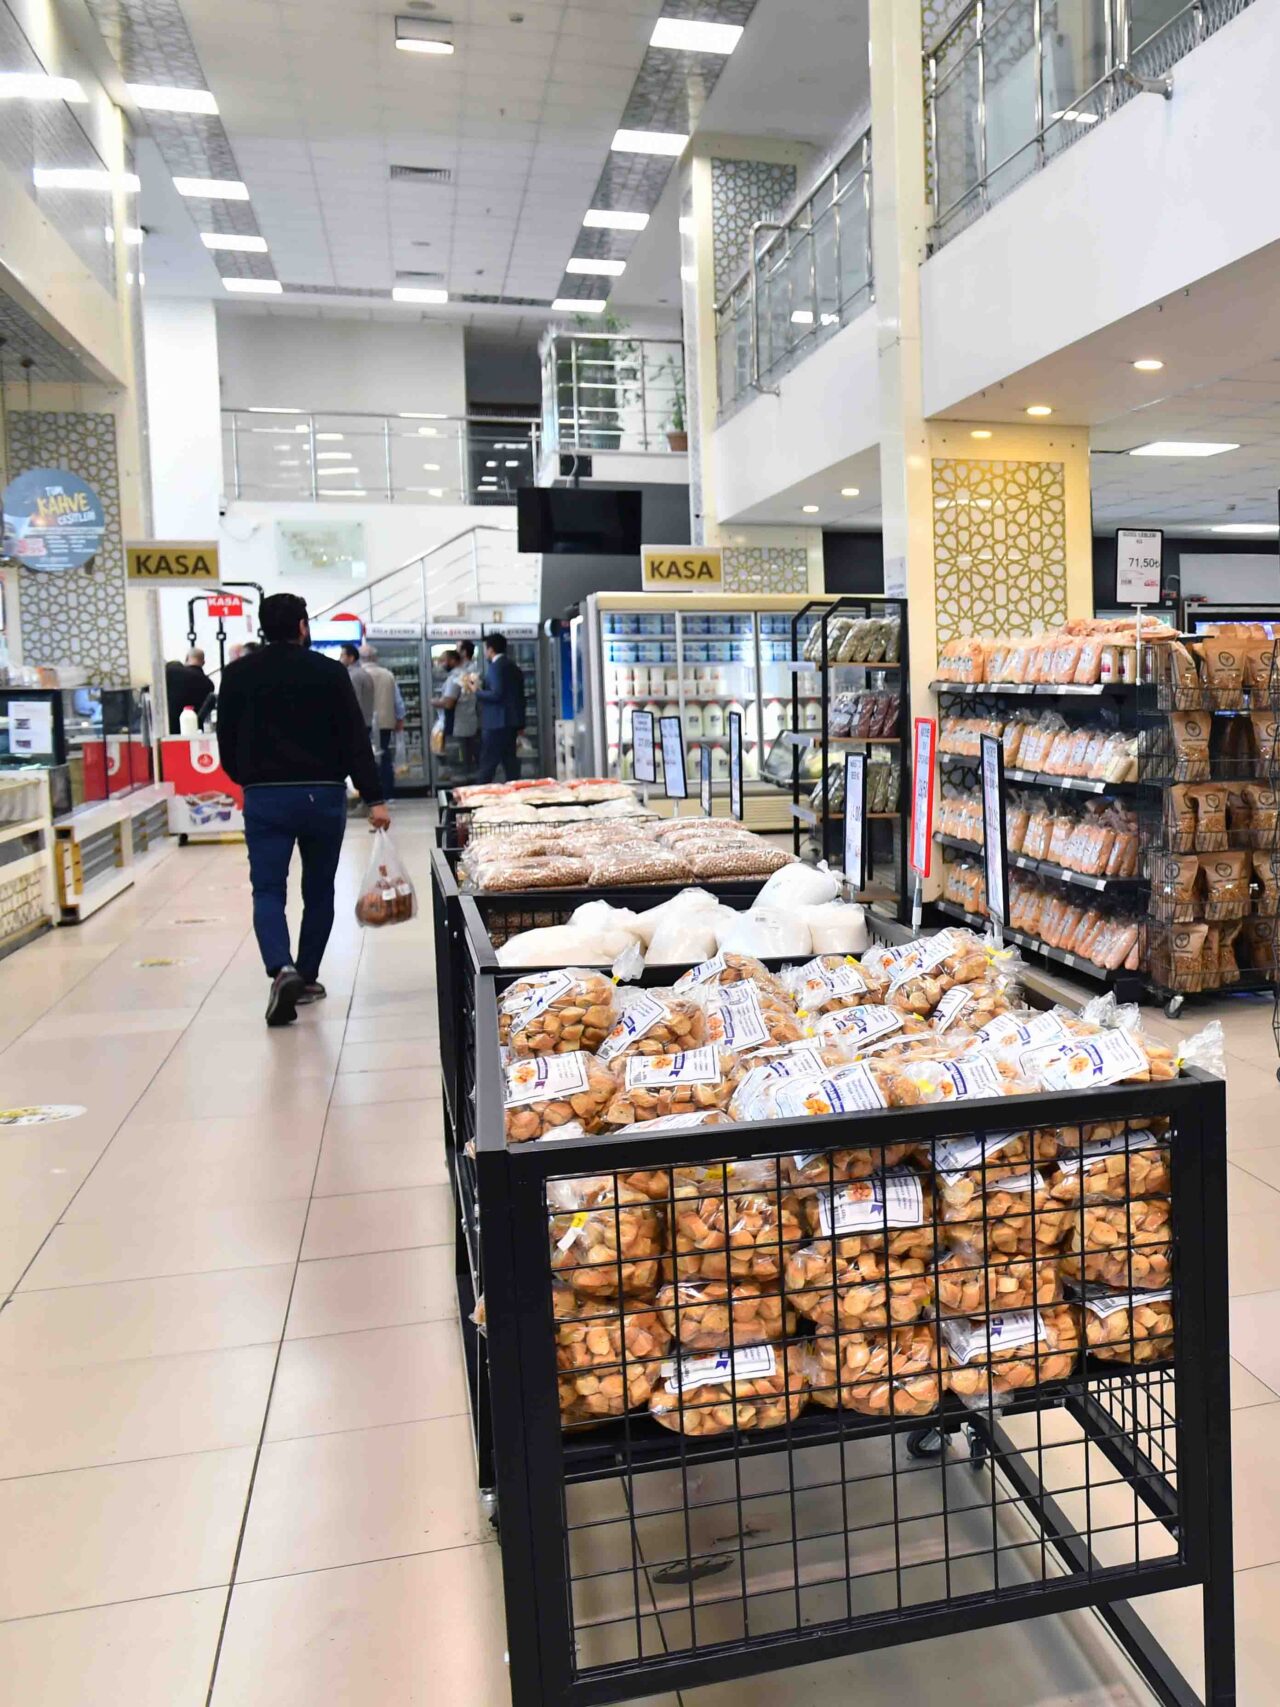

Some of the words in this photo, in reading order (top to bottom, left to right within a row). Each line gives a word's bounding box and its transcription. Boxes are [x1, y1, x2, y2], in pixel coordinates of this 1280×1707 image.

[37, 493, 90, 518] KAHVE
[136, 555, 212, 575] KASA
[651, 560, 714, 580] KASA
[208, 597, 242, 606] KASA
[222, 607, 229, 615] 1
